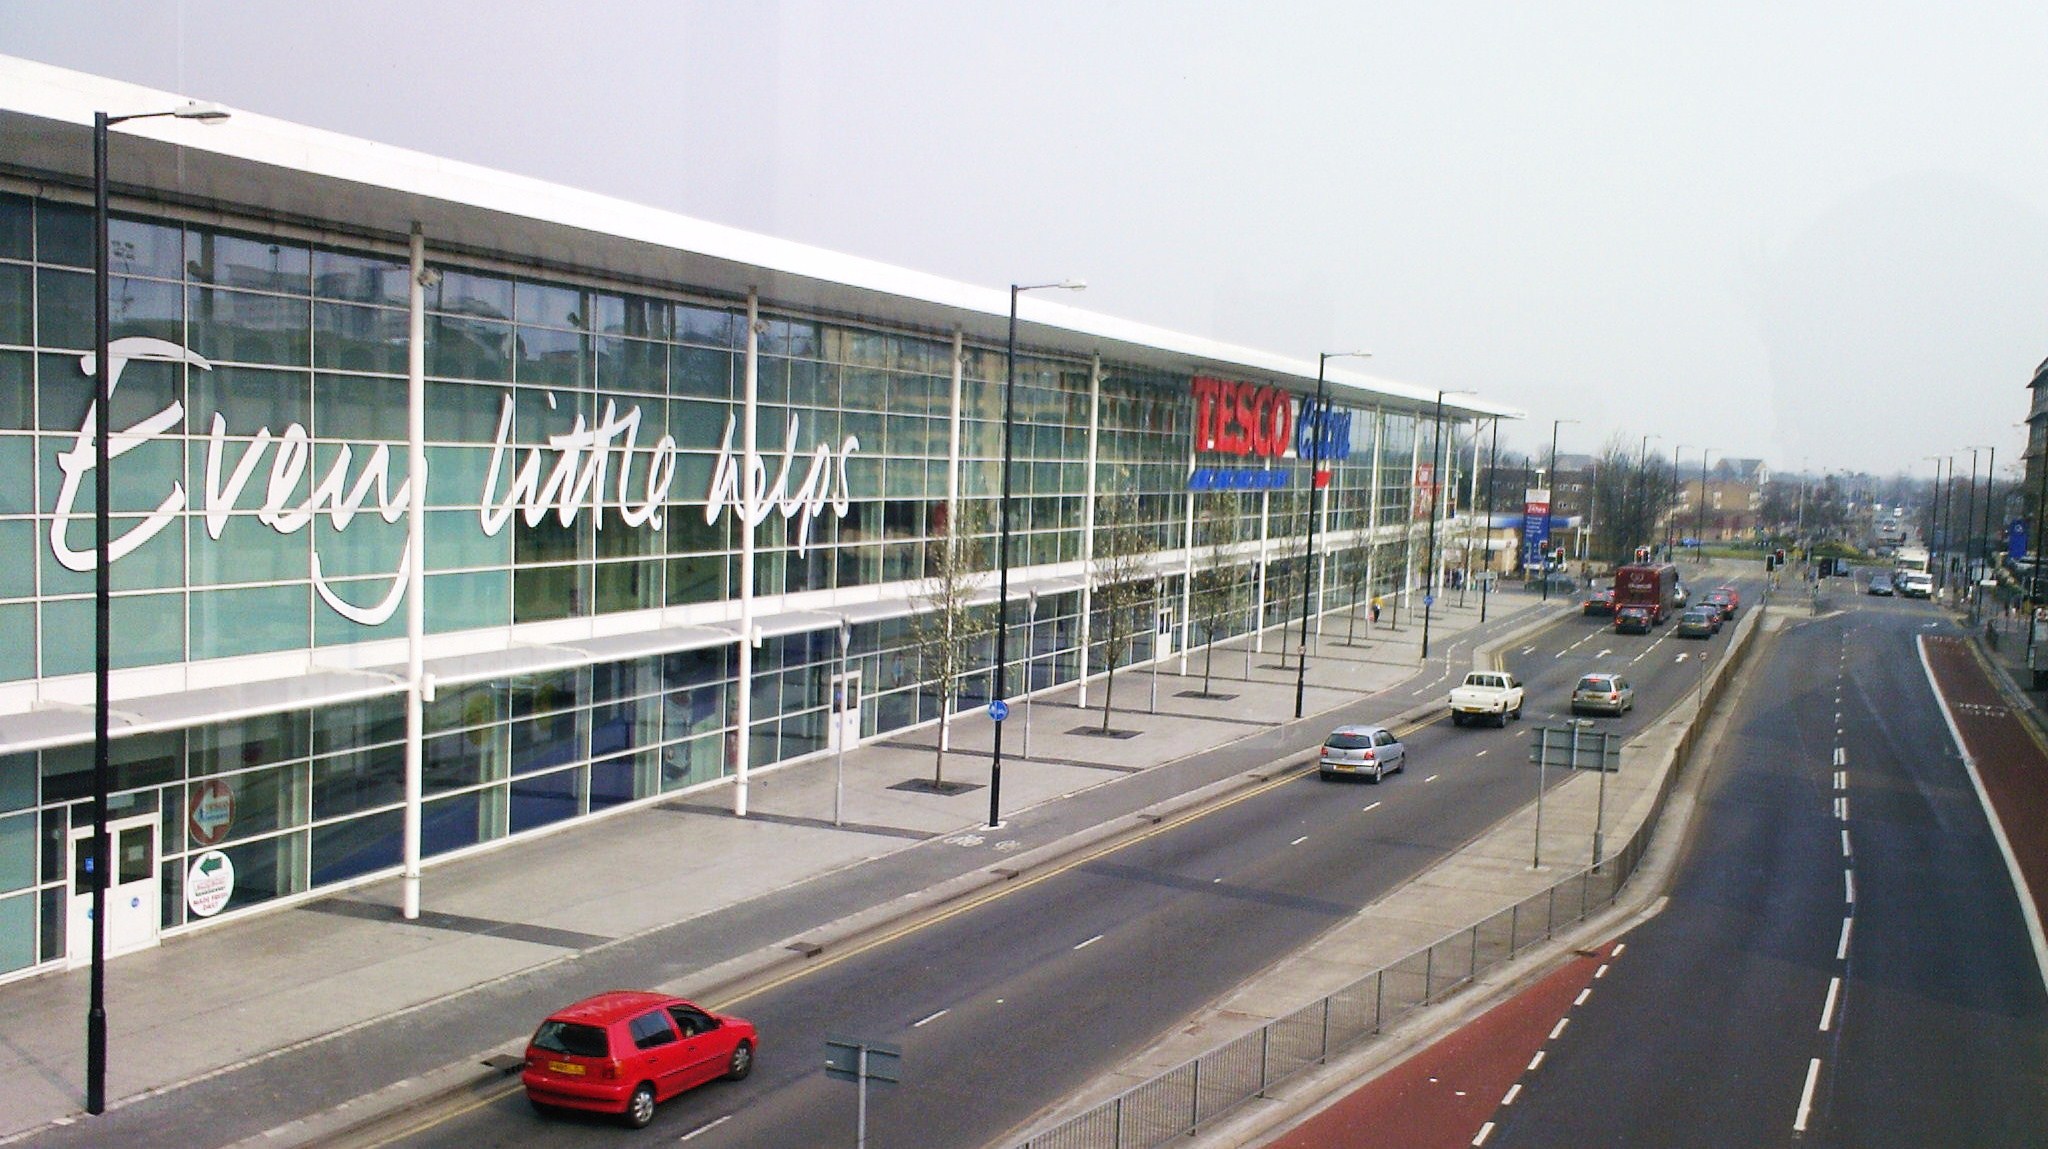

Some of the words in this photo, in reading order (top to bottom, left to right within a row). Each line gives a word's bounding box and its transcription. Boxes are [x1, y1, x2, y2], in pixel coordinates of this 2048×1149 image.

[50, 336, 428, 626] Every
[480, 392, 677, 537] little
[706, 412, 860, 559] helps
[1192, 376, 1291, 457] TESCO
